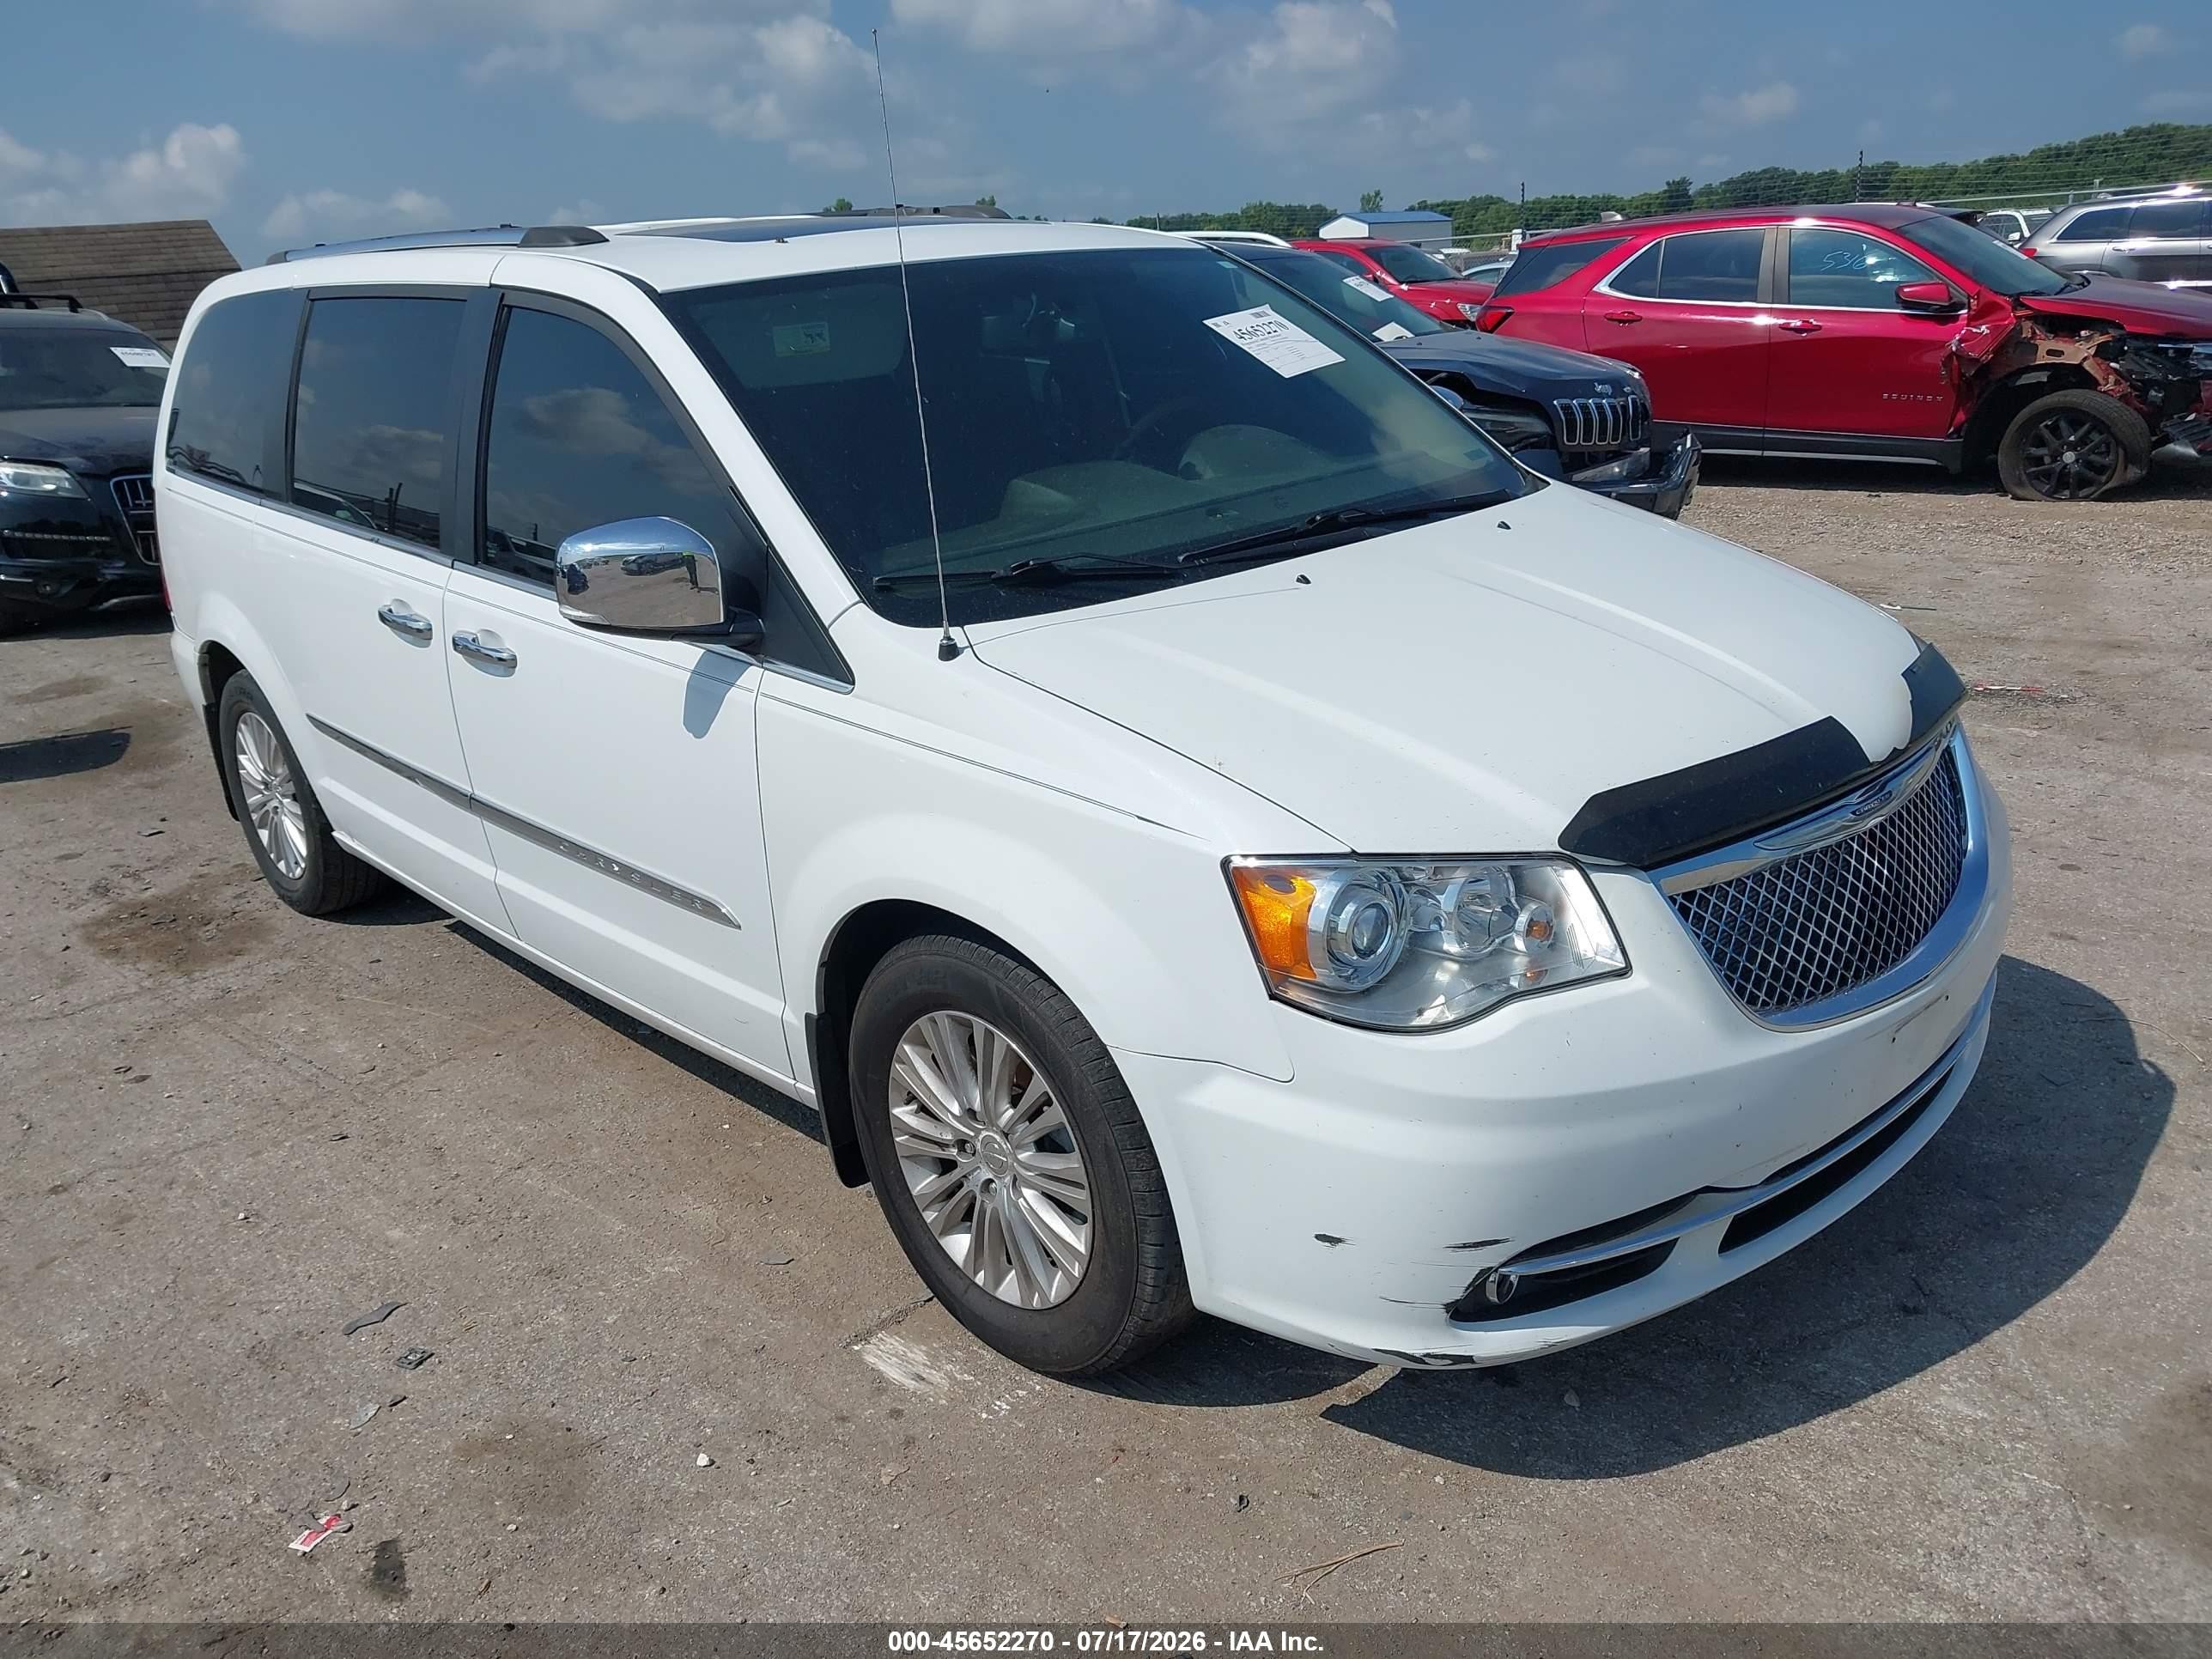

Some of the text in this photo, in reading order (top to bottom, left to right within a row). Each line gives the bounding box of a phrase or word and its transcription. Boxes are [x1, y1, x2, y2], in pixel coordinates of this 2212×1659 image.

[1232, 319, 1290, 341] 45652270
[1594, 381, 1612, 395] Jeep
[1882, 393, 1943, 402] EQUINOX
